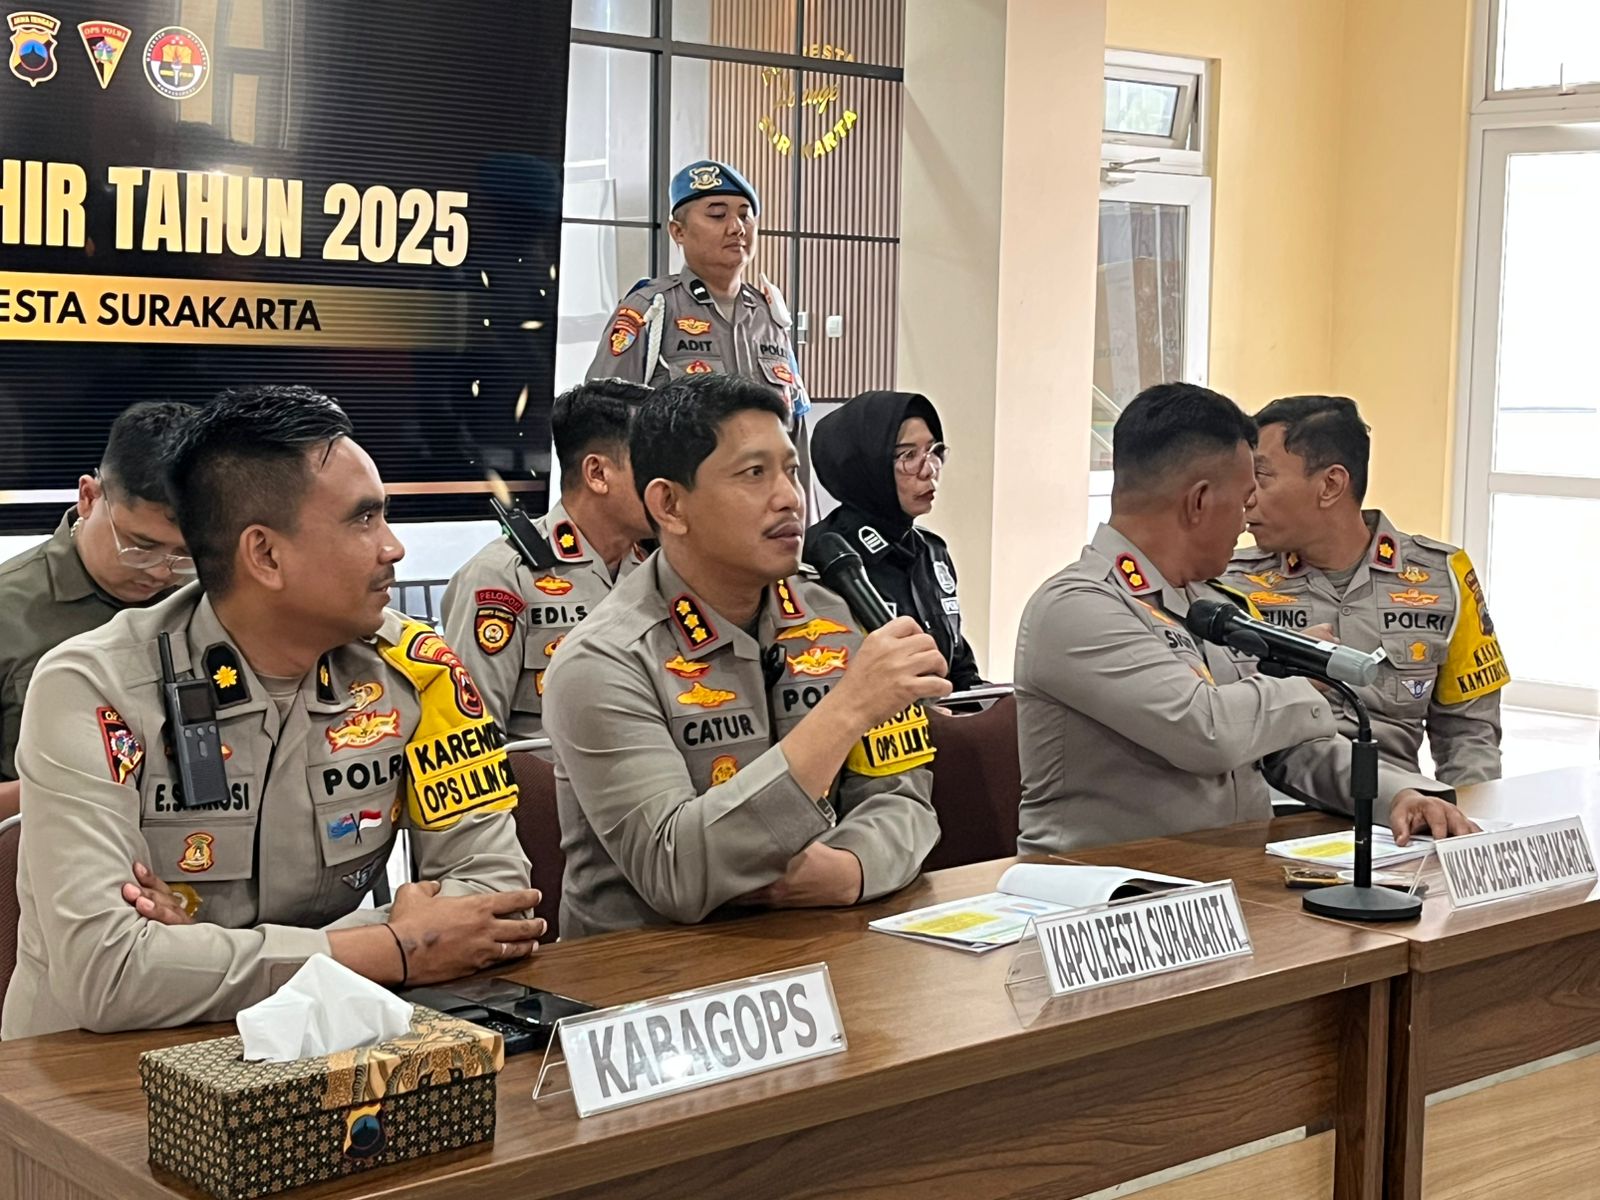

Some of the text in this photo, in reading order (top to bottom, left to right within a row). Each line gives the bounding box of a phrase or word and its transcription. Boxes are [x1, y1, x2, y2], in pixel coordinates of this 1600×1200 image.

[101, 27, 126, 40] POLRI
[108, 166, 303, 259] TAHUN
[322, 182, 470, 268] 2025
[96, 291, 323, 332] SURAKARTA
[677, 339, 712, 352] ADIT
[478, 590, 523, 612] PELOPOR
[1384, 611, 1446, 631] POLRI
[683, 712, 756, 746] CATUR
[876, 734, 899, 764] OPS
[423, 777, 463, 814] OPS
[460, 763, 501, 801] LILIN
[1443, 827, 1595, 899] WAKAPOLRESTA SURAKARTA
[1046, 894, 1243, 989] KAPOLRESTA SURAKARTA
[588, 982, 818, 1099] KABAGOPS
